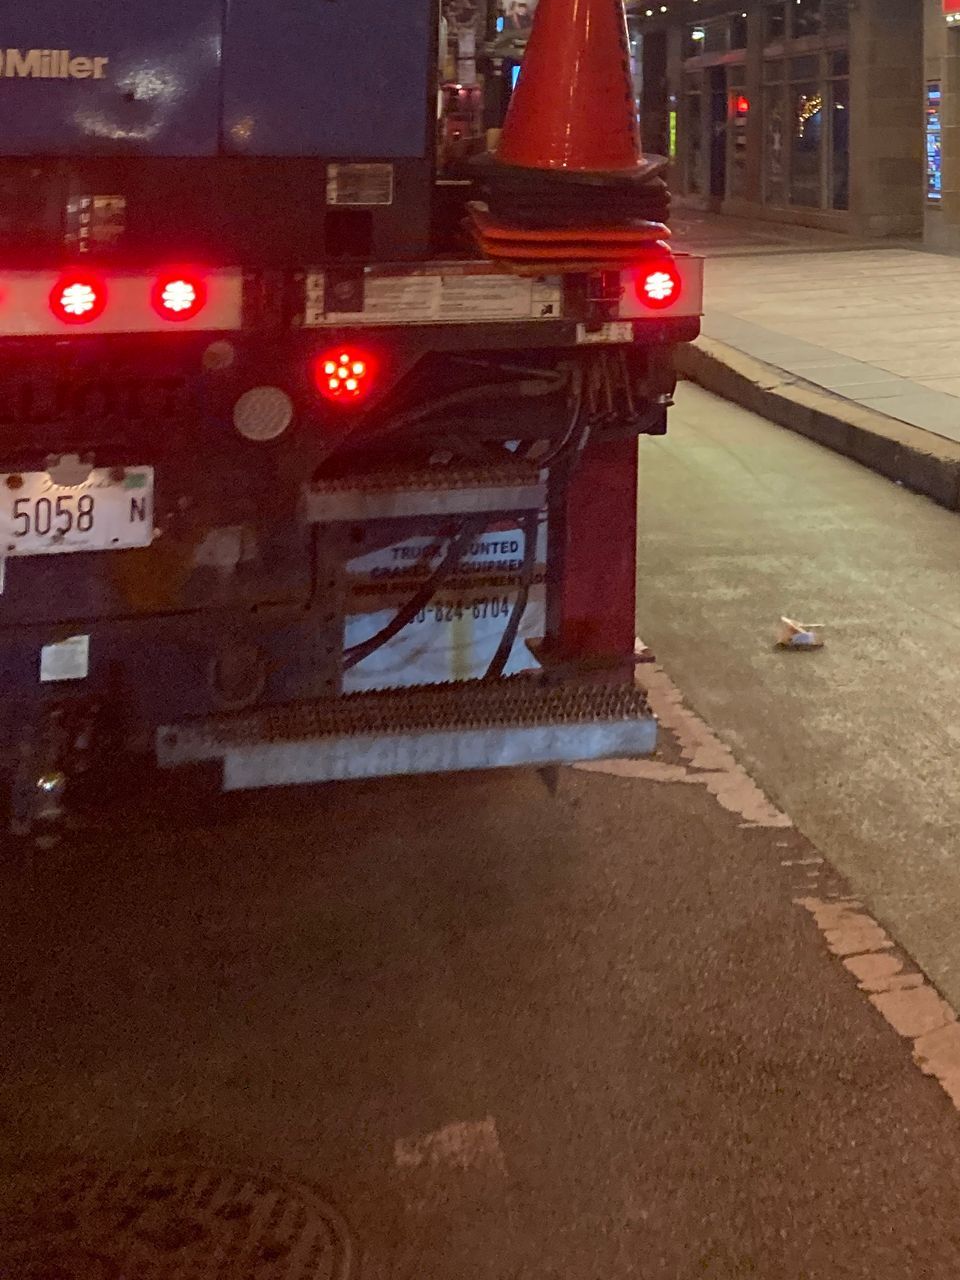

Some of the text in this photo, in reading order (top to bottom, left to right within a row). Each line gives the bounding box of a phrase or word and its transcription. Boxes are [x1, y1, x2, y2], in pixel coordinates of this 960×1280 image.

[5, 48, 109, 79] Miller
[13, 494, 146, 537] 5058 N
[462, 539, 520, 557] UNTED
[409, 596, 509, 624] 0-824-6704
